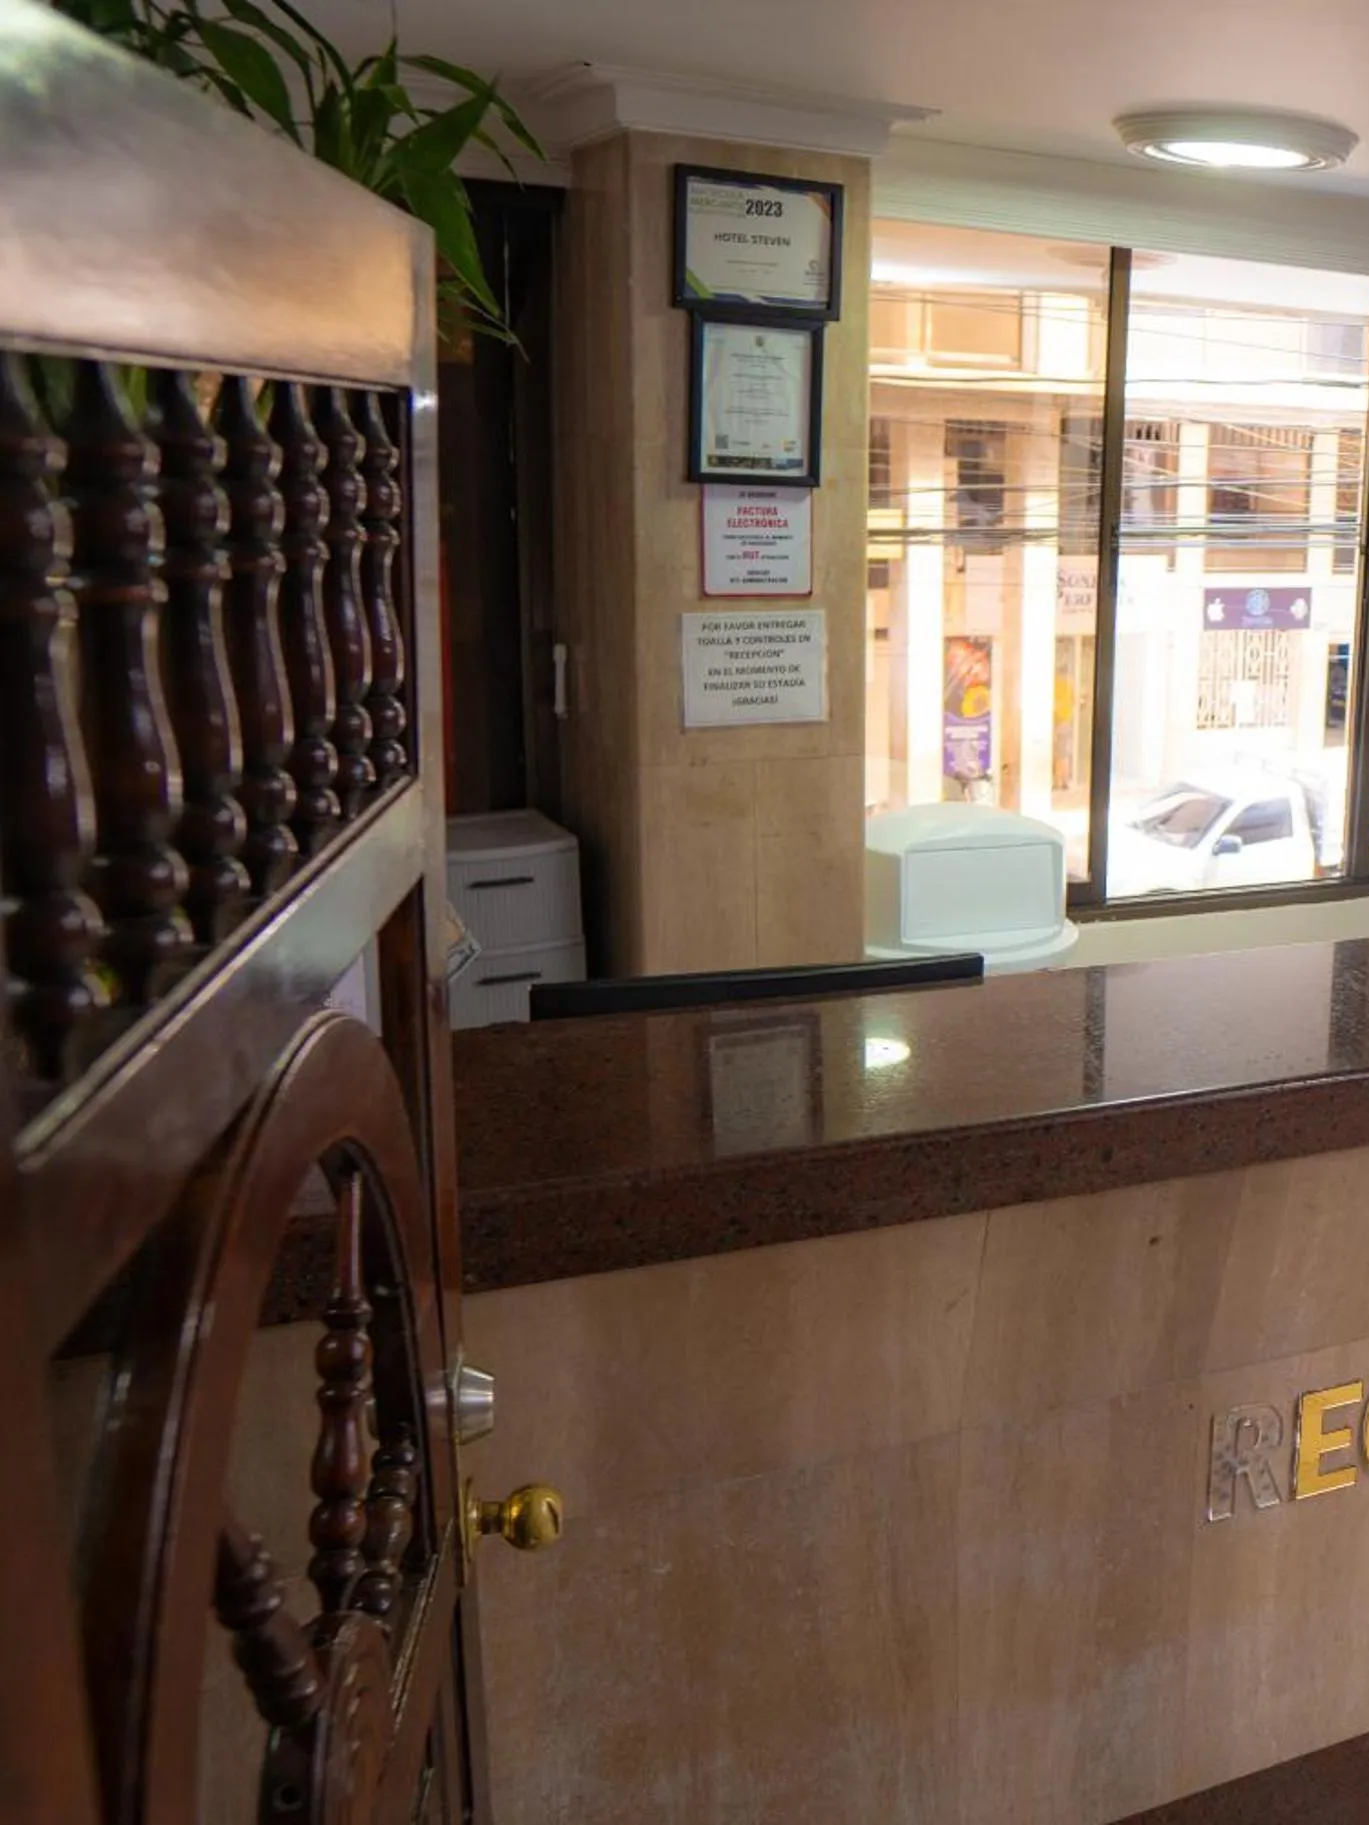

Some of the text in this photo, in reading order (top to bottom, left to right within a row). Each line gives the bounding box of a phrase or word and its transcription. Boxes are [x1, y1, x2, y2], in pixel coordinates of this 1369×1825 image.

[746, 199, 783, 217] 2023
[714, 232, 791, 247] HOTEL STEVEN
[737, 506, 778, 516] FACTURA
[702, 620, 806, 632] POR FAVOR ENTREGAR
[697, 636, 733, 647] TOALLA
[741, 634, 796, 645] CONTROLES
[799, 634, 811, 643] EN
[708, 664, 801, 677] EN EL MOMENTO DE
[703, 682, 751, 692] FINALIZAR
[753, 680, 766, 689] SU
